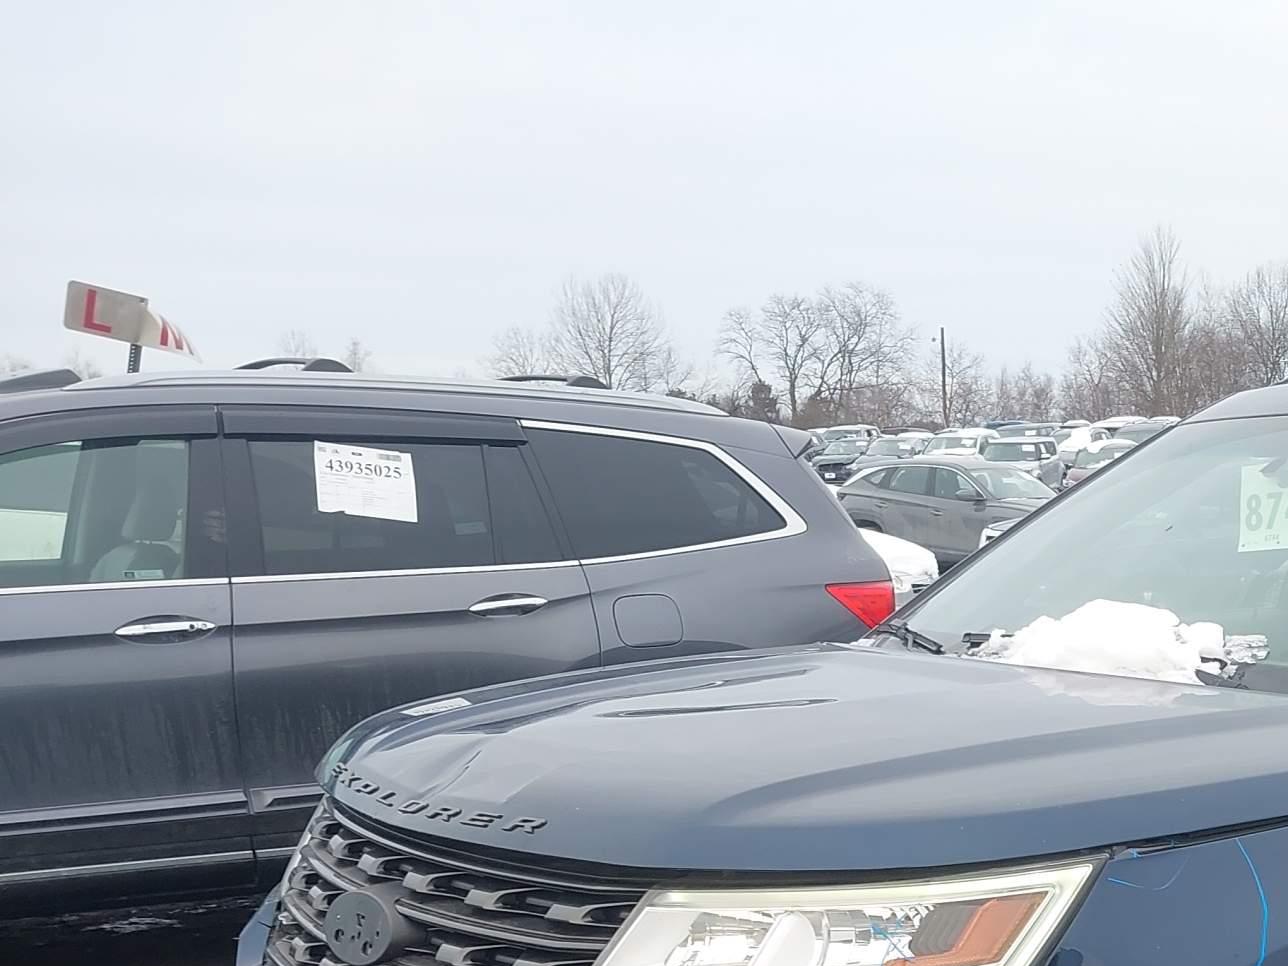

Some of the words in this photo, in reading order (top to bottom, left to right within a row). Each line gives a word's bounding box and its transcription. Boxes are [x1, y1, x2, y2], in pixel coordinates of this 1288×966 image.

[83, 288, 112, 333] L
[325, 459, 402, 480] 43935025
[331, 762, 549, 835] EXPLORER
